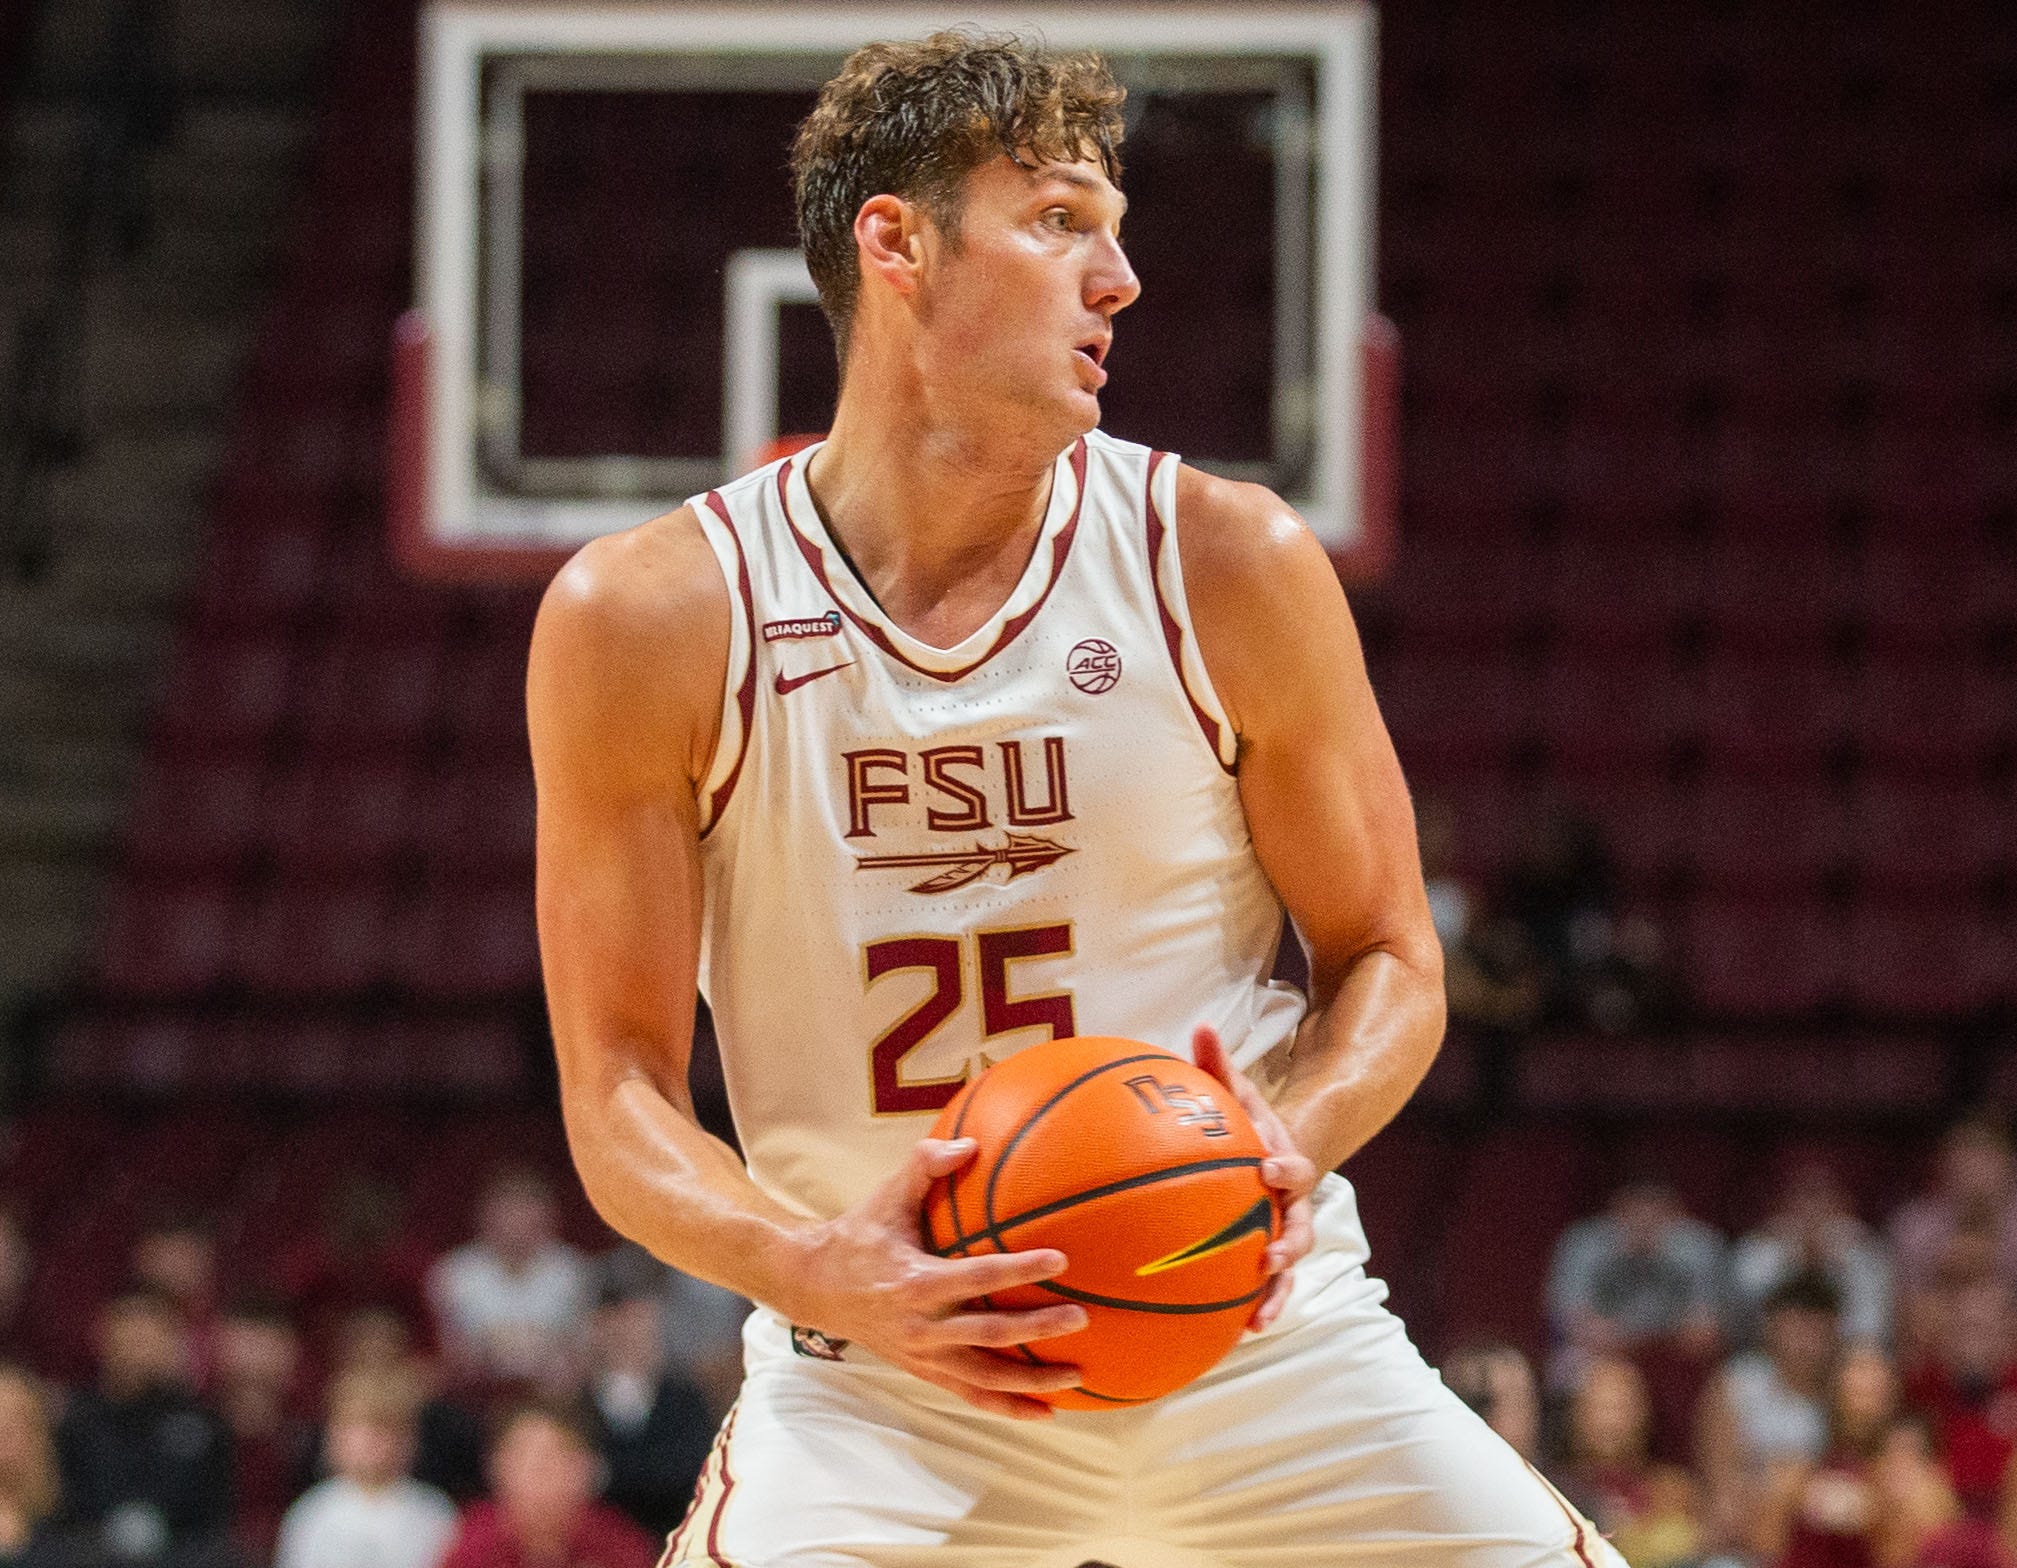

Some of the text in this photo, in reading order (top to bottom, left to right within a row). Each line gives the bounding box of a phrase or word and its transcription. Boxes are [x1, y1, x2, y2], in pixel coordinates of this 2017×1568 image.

[1074, 654, 1117, 670] ACC
[840, 737, 1076, 838] FSU
[861, 919, 1076, 1118] 25
